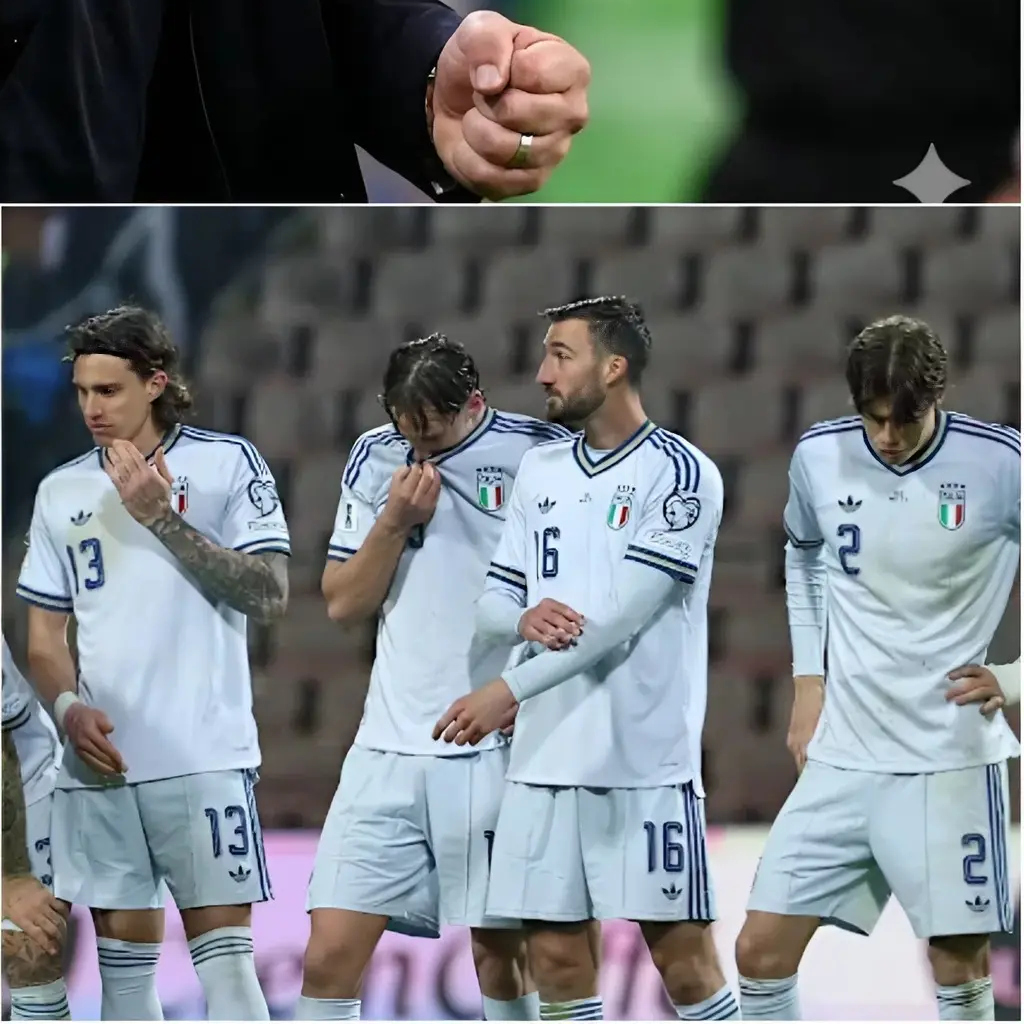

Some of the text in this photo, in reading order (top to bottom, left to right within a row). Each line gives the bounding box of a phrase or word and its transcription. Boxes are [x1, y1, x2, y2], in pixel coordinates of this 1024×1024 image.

[66, 537, 105, 595] 13
[534, 526, 561, 583] 16
[837, 523, 861, 575] 2
[204, 805, 249, 859] 13
[643, 821, 685, 873] 16
[961, 833, 988, 885] 2
